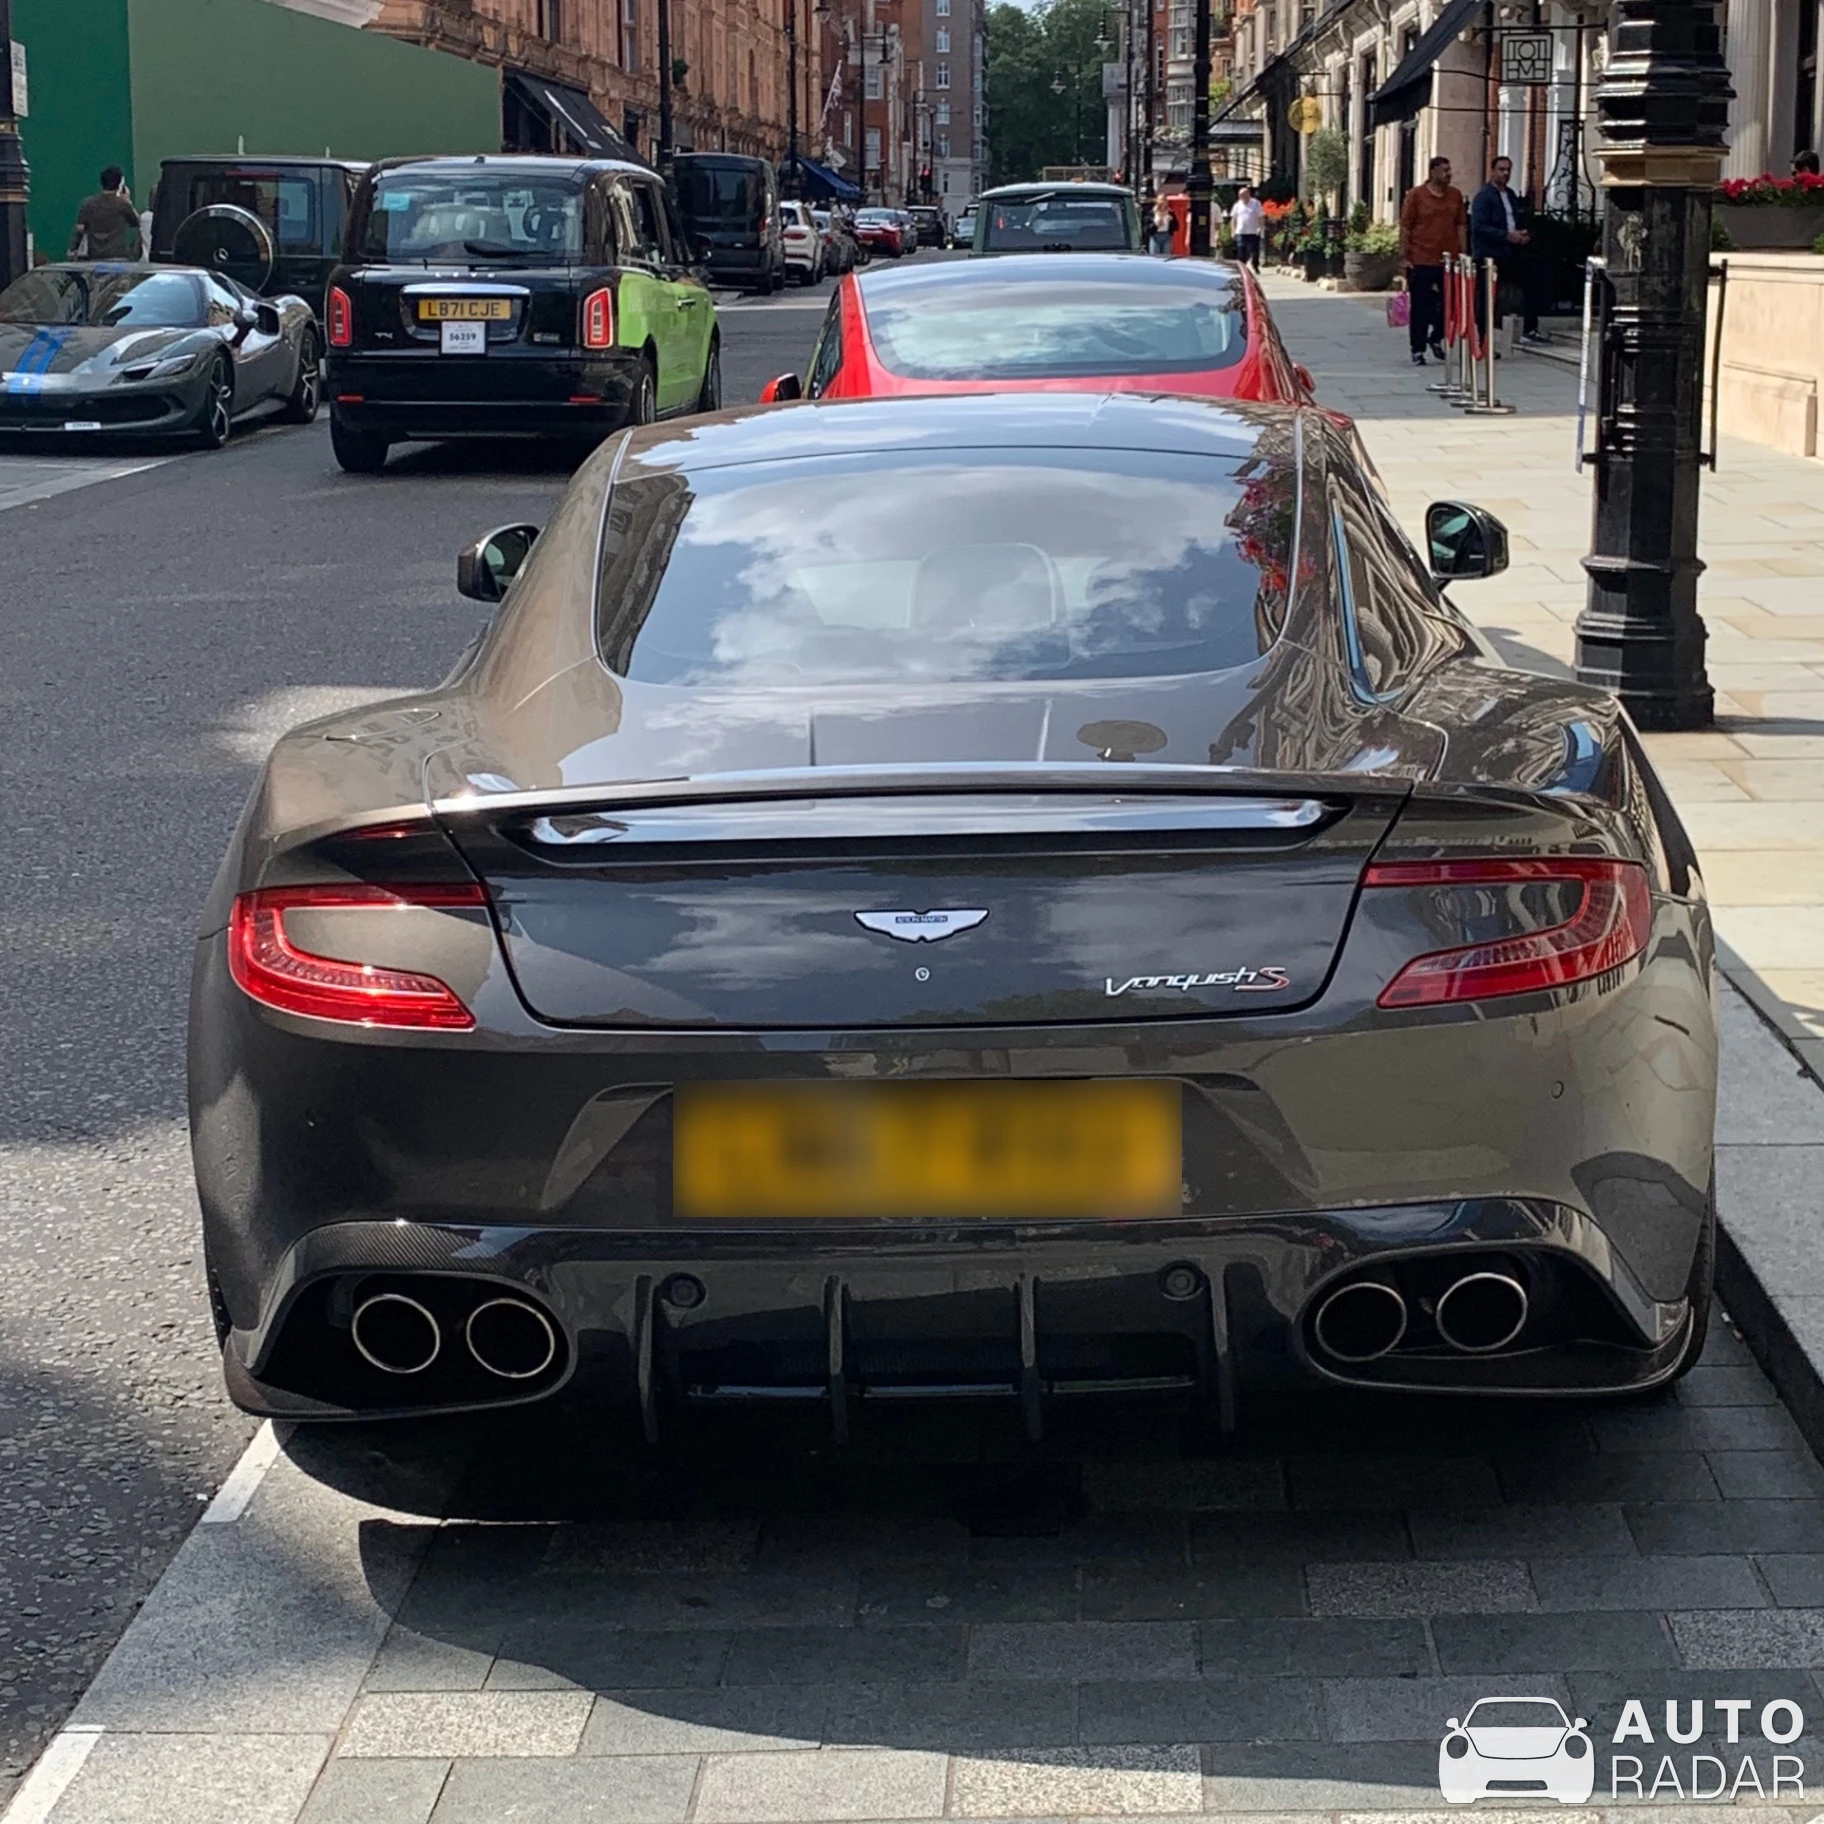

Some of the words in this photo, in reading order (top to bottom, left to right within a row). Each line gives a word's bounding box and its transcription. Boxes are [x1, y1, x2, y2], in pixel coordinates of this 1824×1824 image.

[427, 302, 464, 316] LB71
[469, 302, 500, 316] CJE
[1105, 966, 1257, 997] Vanquish
